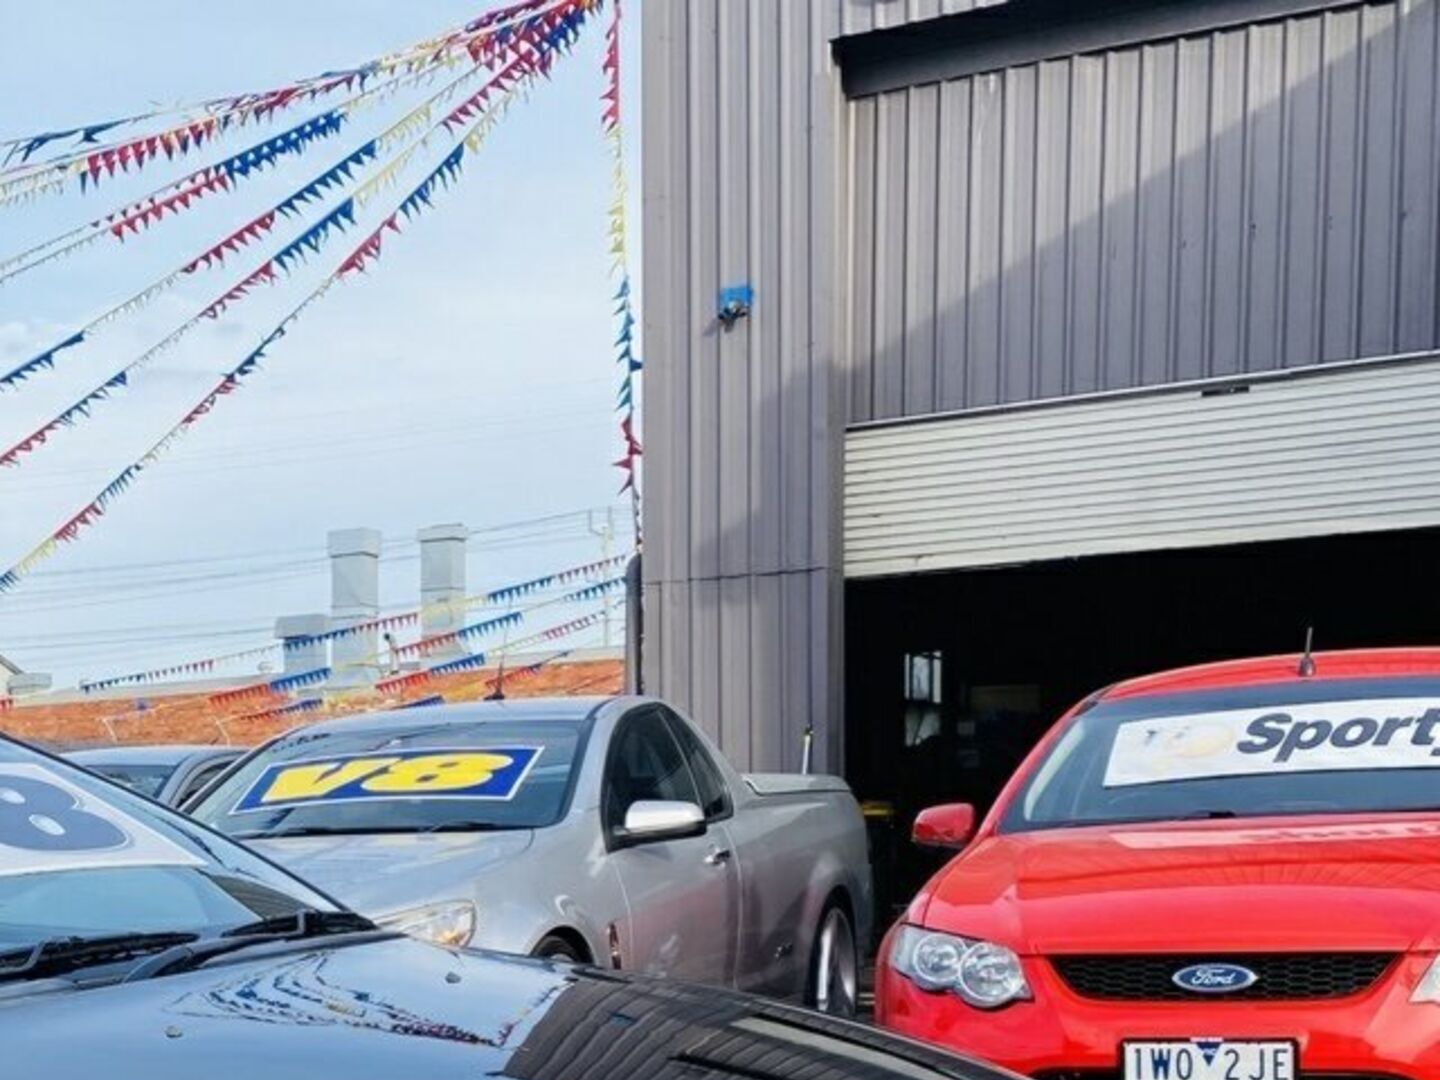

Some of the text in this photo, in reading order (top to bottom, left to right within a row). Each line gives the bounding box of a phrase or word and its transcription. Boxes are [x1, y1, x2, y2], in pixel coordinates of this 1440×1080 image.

[1236, 708, 1440, 762] Sport
[262, 752, 516, 802] V8
[1191, 965, 1237, 985] Ford
